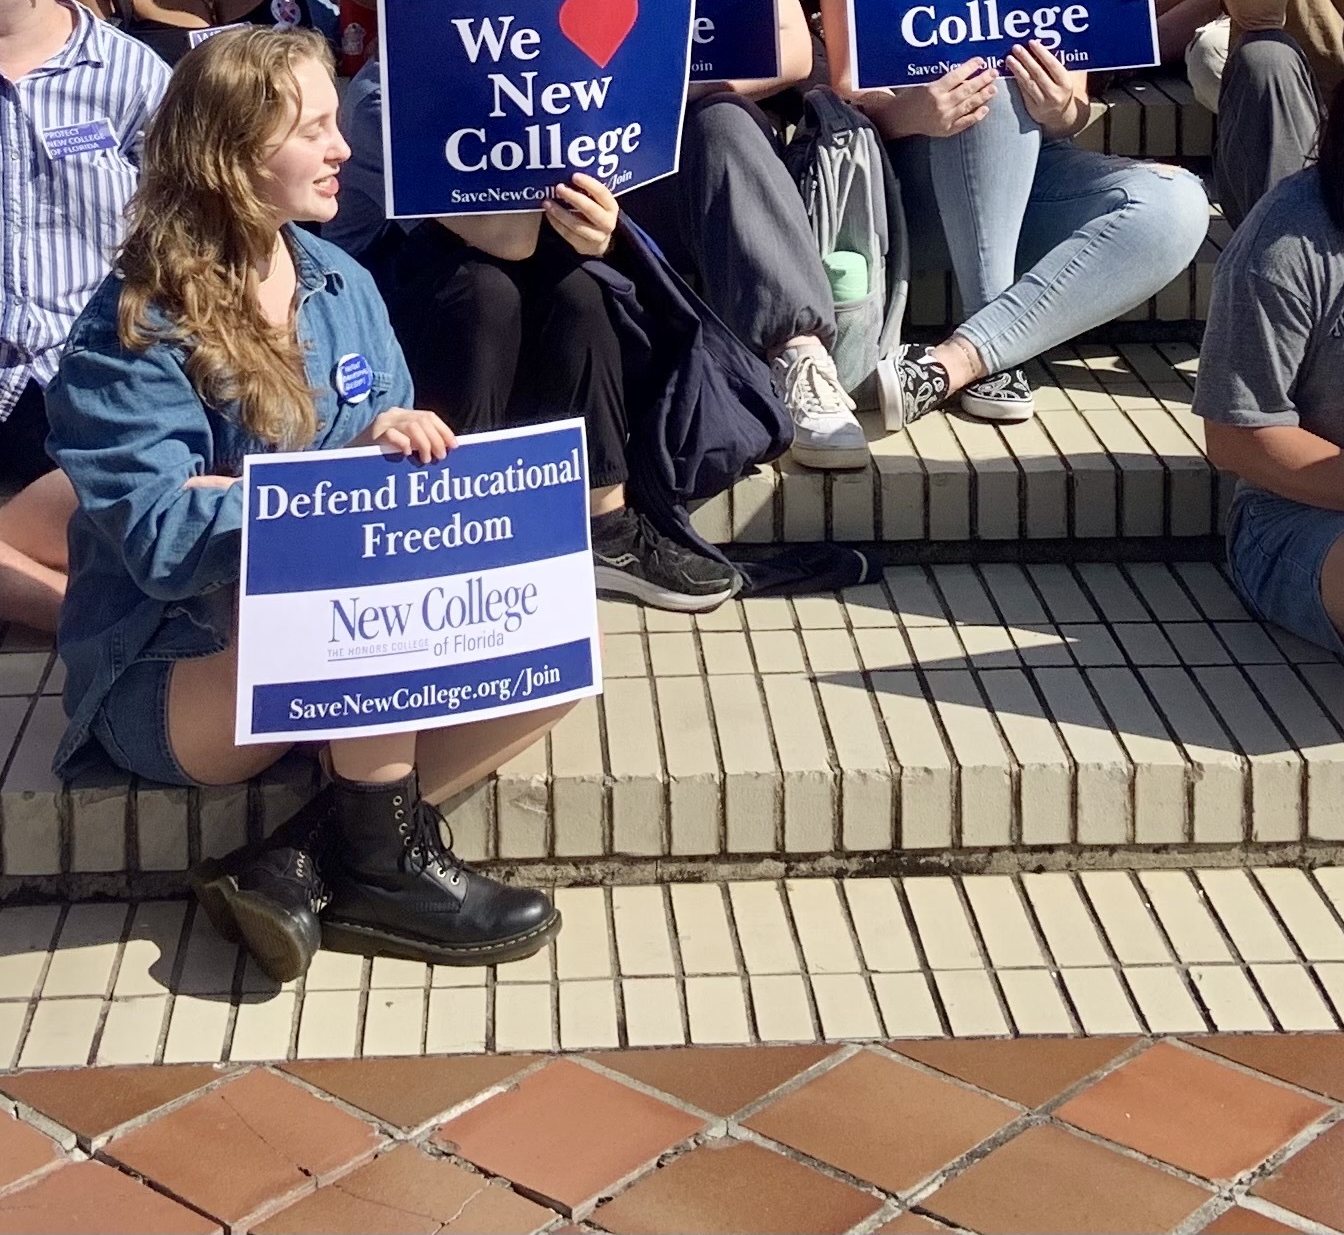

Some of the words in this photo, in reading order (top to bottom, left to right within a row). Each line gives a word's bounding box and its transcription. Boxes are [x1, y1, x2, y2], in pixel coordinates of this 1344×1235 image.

[46, 138, 67, 148] NEW
[68, 133, 106, 144] COLLEGE
[63, 142, 99, 153] FLORIDA
[255, 475, 399, 522] Defend
[406, 449, 583, 509] Educational
[360, 513, 513, 559] Freedom
[327, 597, 414, 644] New
[421, 575, 539, 633] College
[327, 647, 345, 659] THE
[347, 642, 388, 656] HONORS
[391, 637, 429, 652] COLLEGE
[433, 635, 450, 657] of
[454, 628, 505, 654] Florida
[289, 664, 562, 721] SaveNewCollege.org/Join
